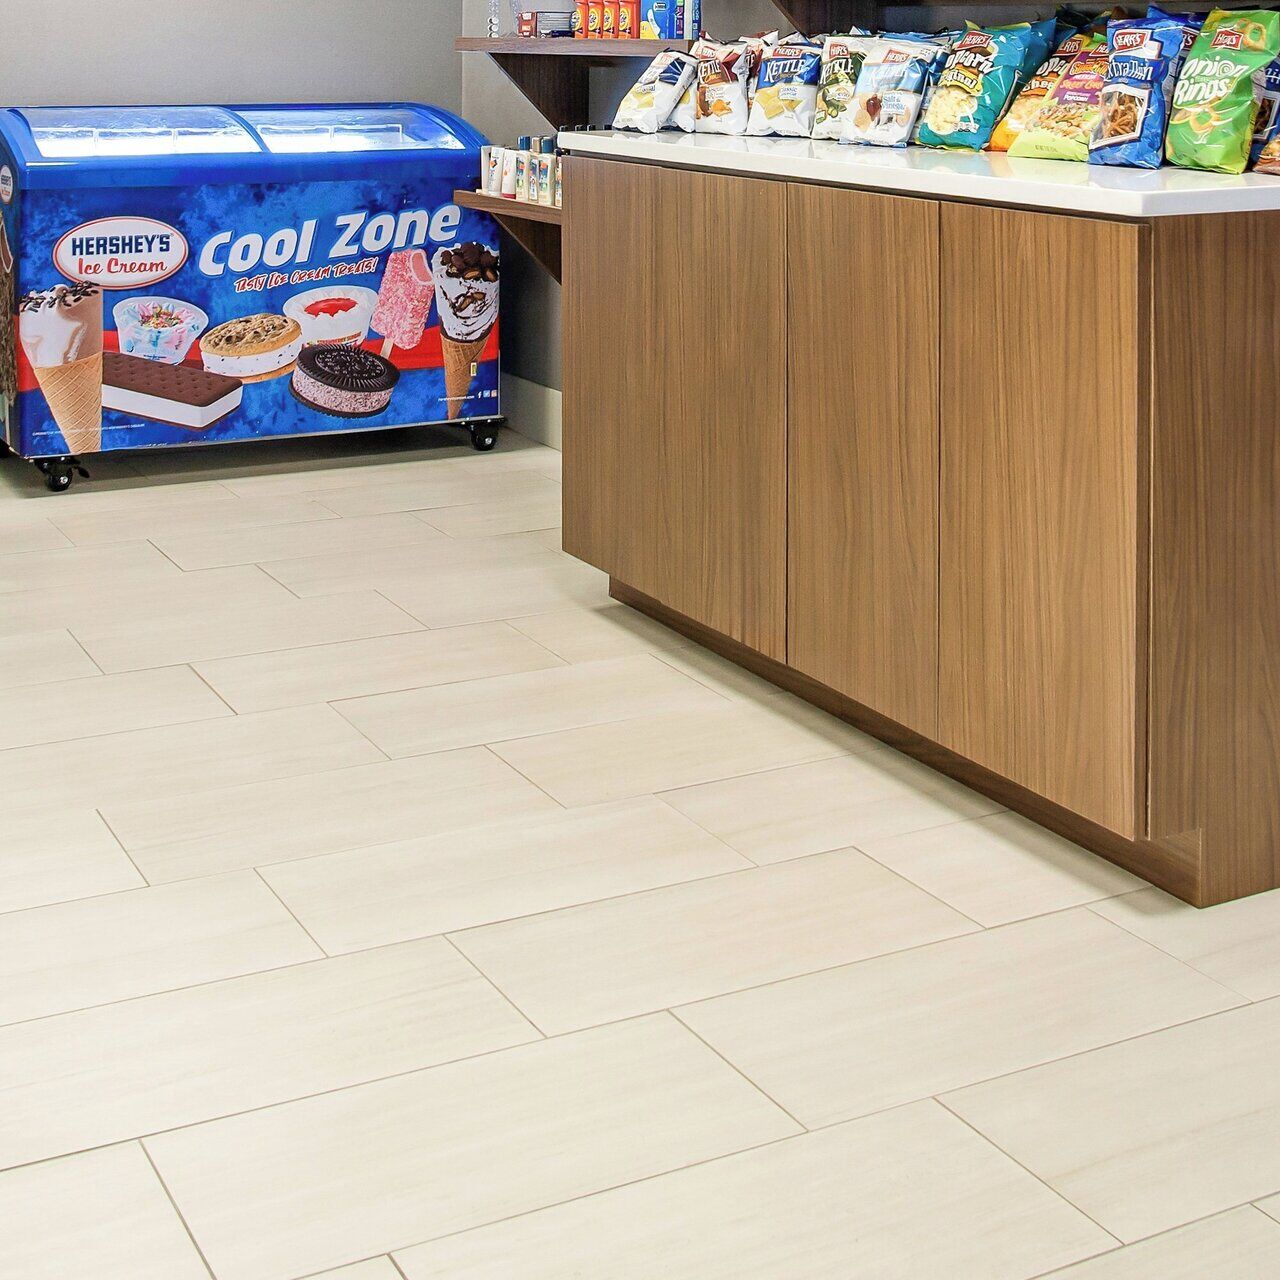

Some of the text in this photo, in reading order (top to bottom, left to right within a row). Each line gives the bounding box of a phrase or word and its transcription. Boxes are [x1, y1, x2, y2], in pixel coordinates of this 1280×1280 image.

[1181, 56, 1249, 80] Onion
[1173, 78, 1230, 104] Rings
[72, 233, 171, 256] HERSHEY'S
[198, 204, 461, 277] Cool Zone
[78, 258, 168, 275] Ice Cream
